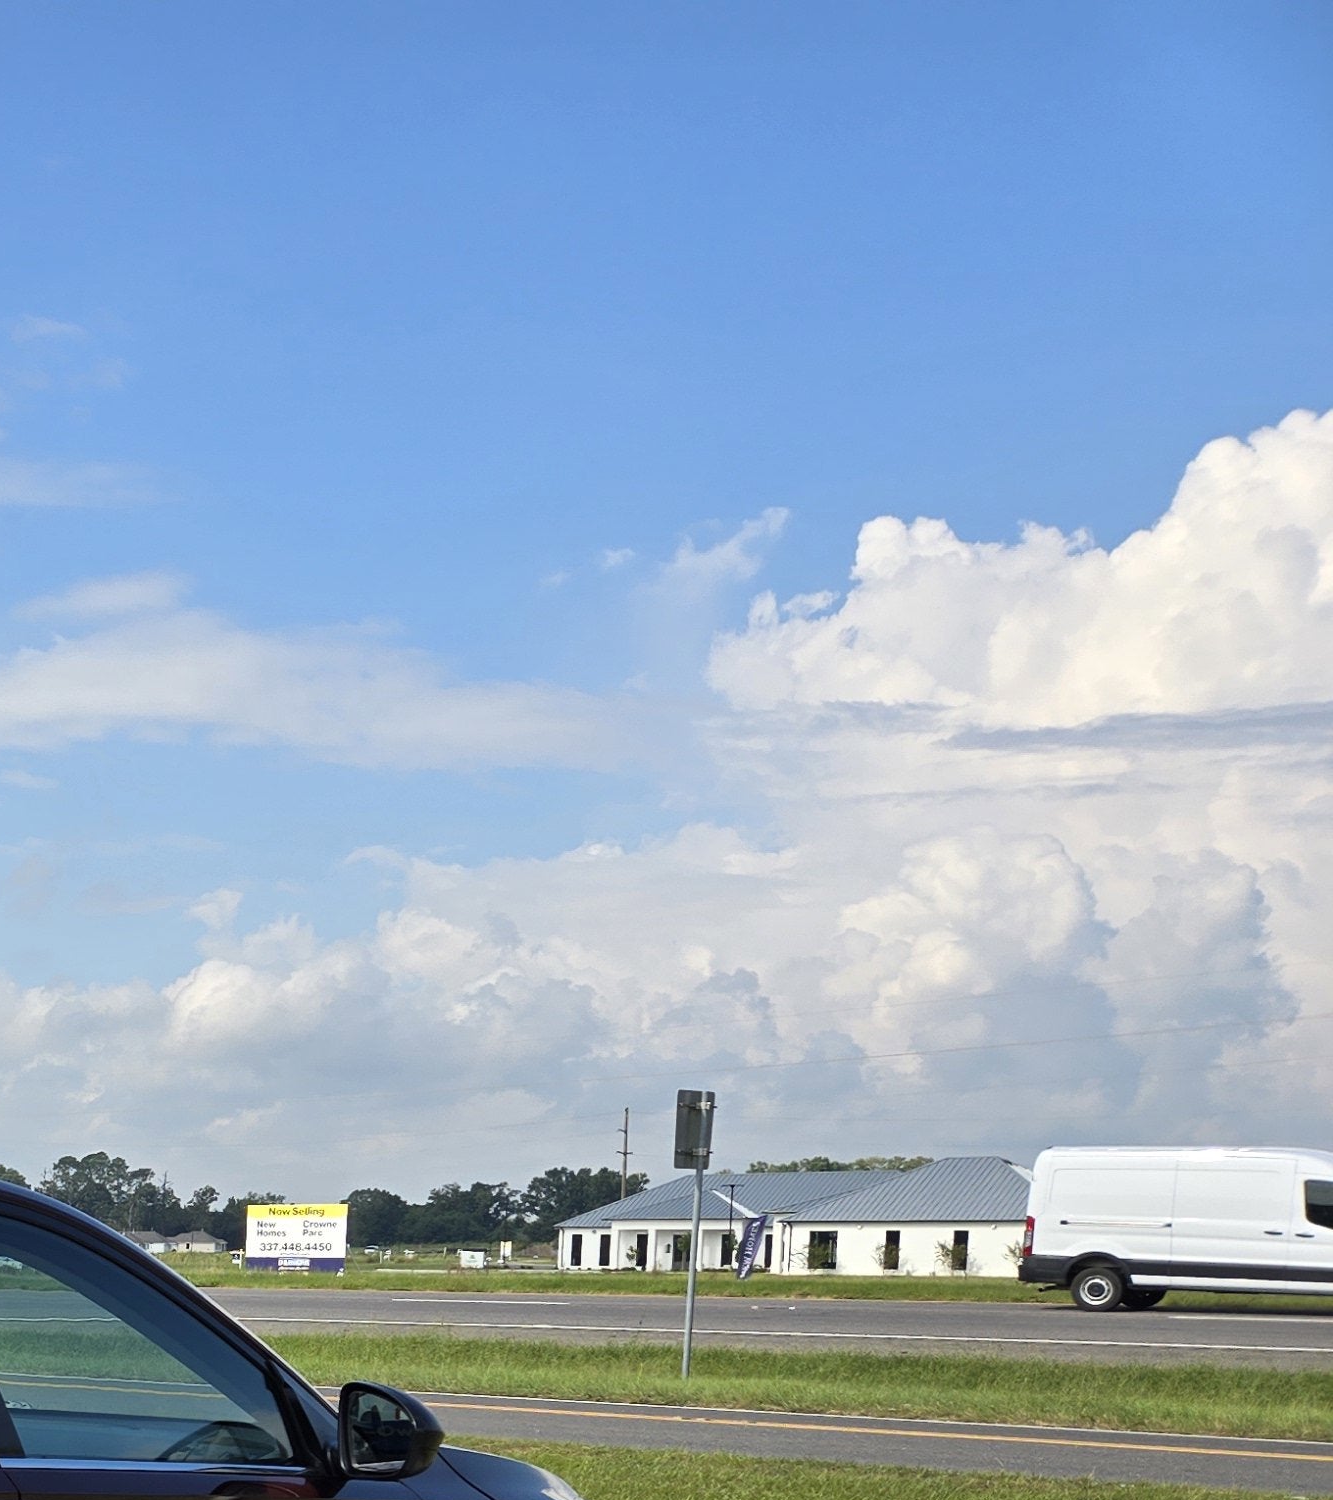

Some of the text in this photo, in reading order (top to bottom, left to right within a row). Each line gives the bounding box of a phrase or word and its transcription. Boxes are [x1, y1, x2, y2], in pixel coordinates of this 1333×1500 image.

[268, 1207, 325, 1218] Now Selling
[302, 1220, 337, 1228] Crowne
[256, 1229, 287, 1237] Homes
